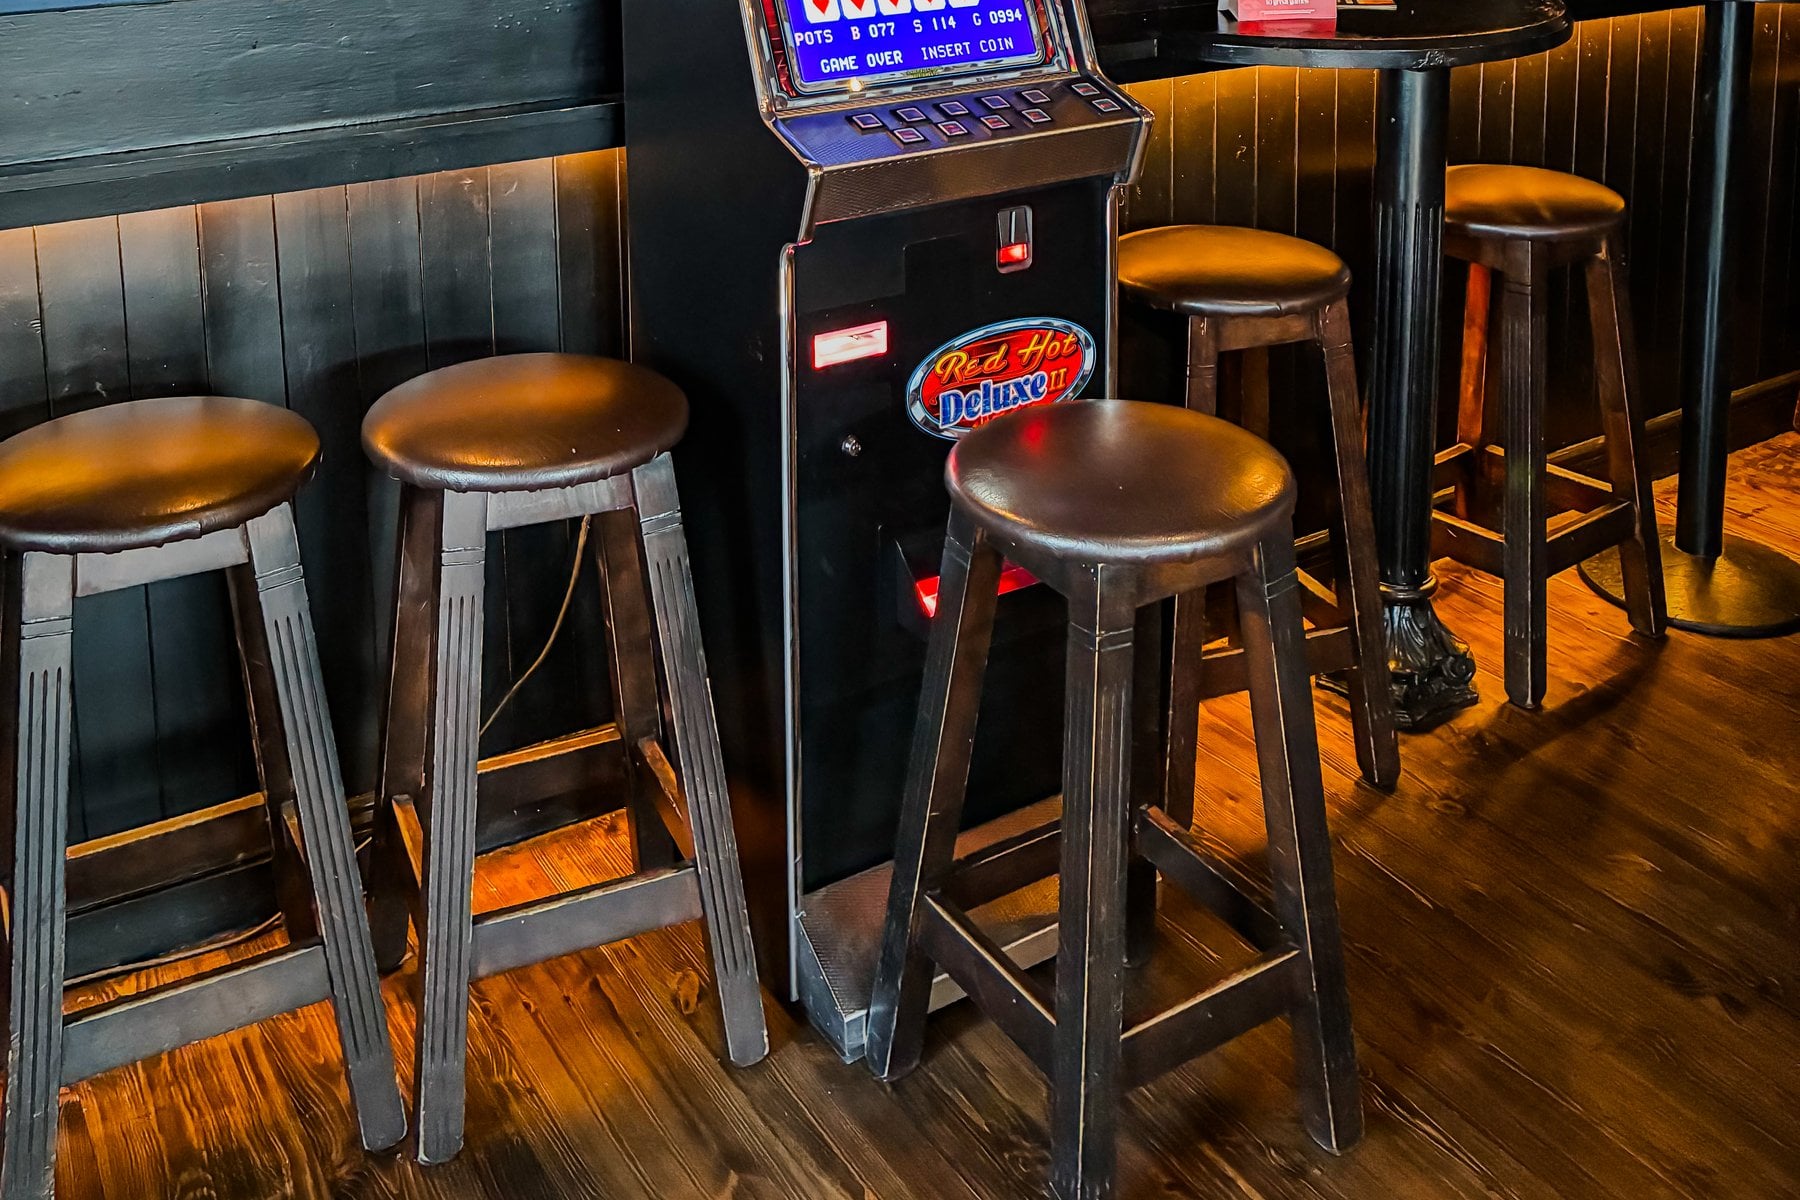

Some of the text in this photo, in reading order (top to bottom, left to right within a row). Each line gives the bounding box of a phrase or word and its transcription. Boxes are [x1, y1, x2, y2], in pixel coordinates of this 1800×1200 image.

[794, 8, 1023, 47] POTS B 077 S 114 G 0994
[820, 37, 1014, 74] GAME OVER INSERT COIN
[934, 330, 1079, 385] Red Hot
[939, 367, 1068, 429] Deluxe II
